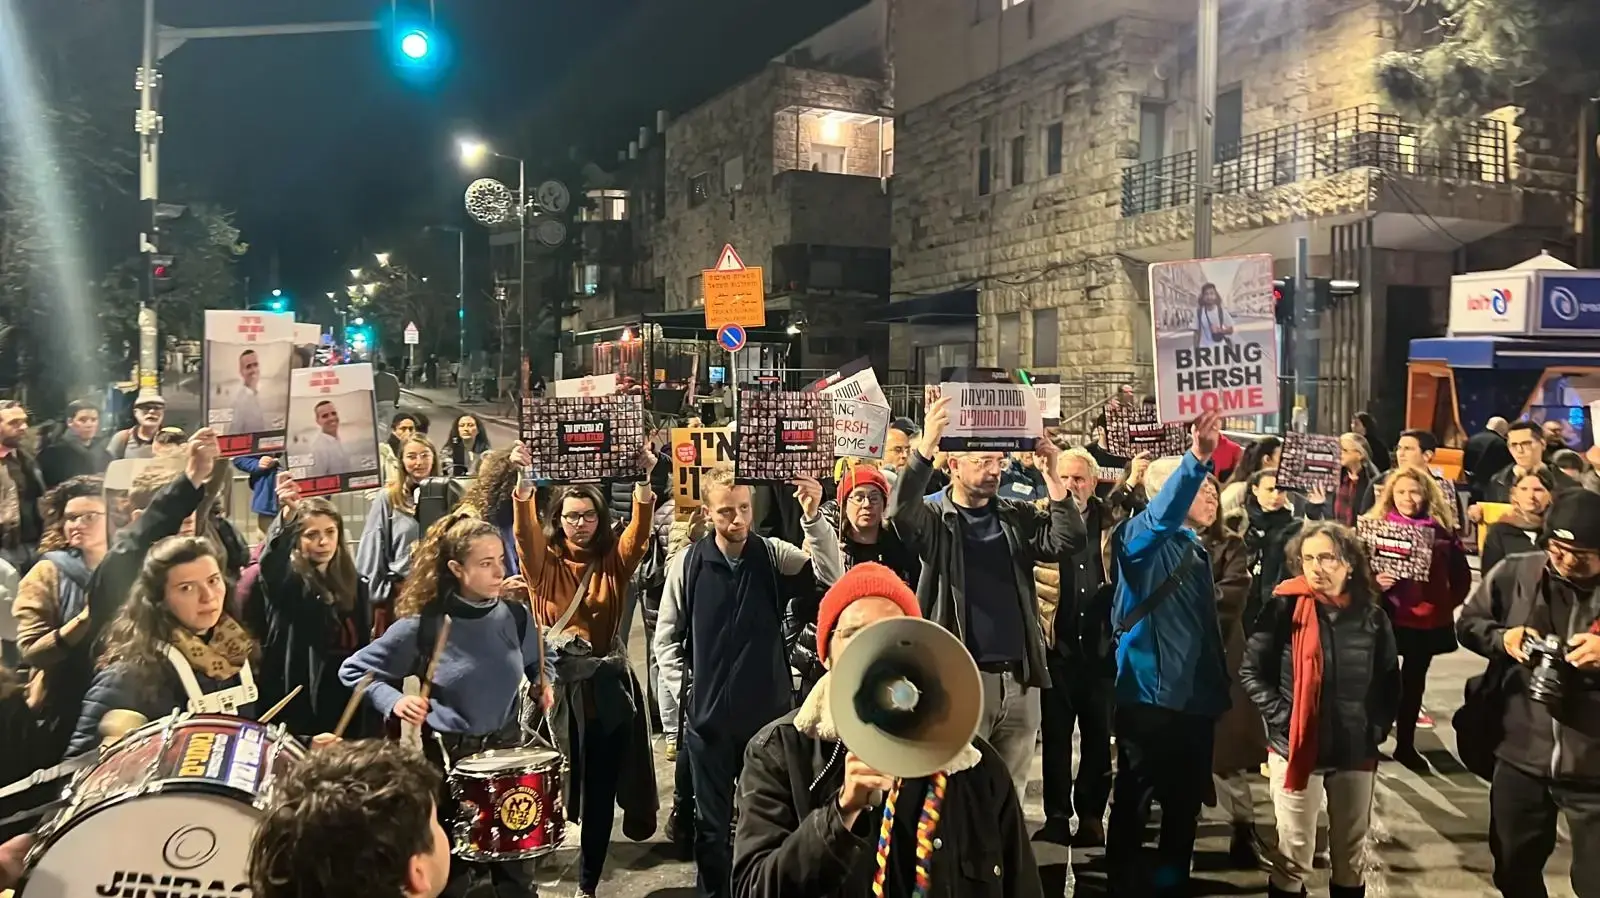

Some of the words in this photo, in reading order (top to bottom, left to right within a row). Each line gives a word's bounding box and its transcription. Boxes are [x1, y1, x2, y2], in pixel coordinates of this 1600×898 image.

[1175, 342, 1263, 369] BRING
[1176, 364, 1262, 392] HERSH
[960, 388, 996, 407] הניצחון
[998, 389, 1025, 407] תמונת
[1178, 387, 1264, 415] HOME
[834, 403, 856, 417] ING
[959, 409, 1001, 427] החטופים
[1002, 409, 1027, 427] שיבת
[835, 419, 869, 435] ERSH
